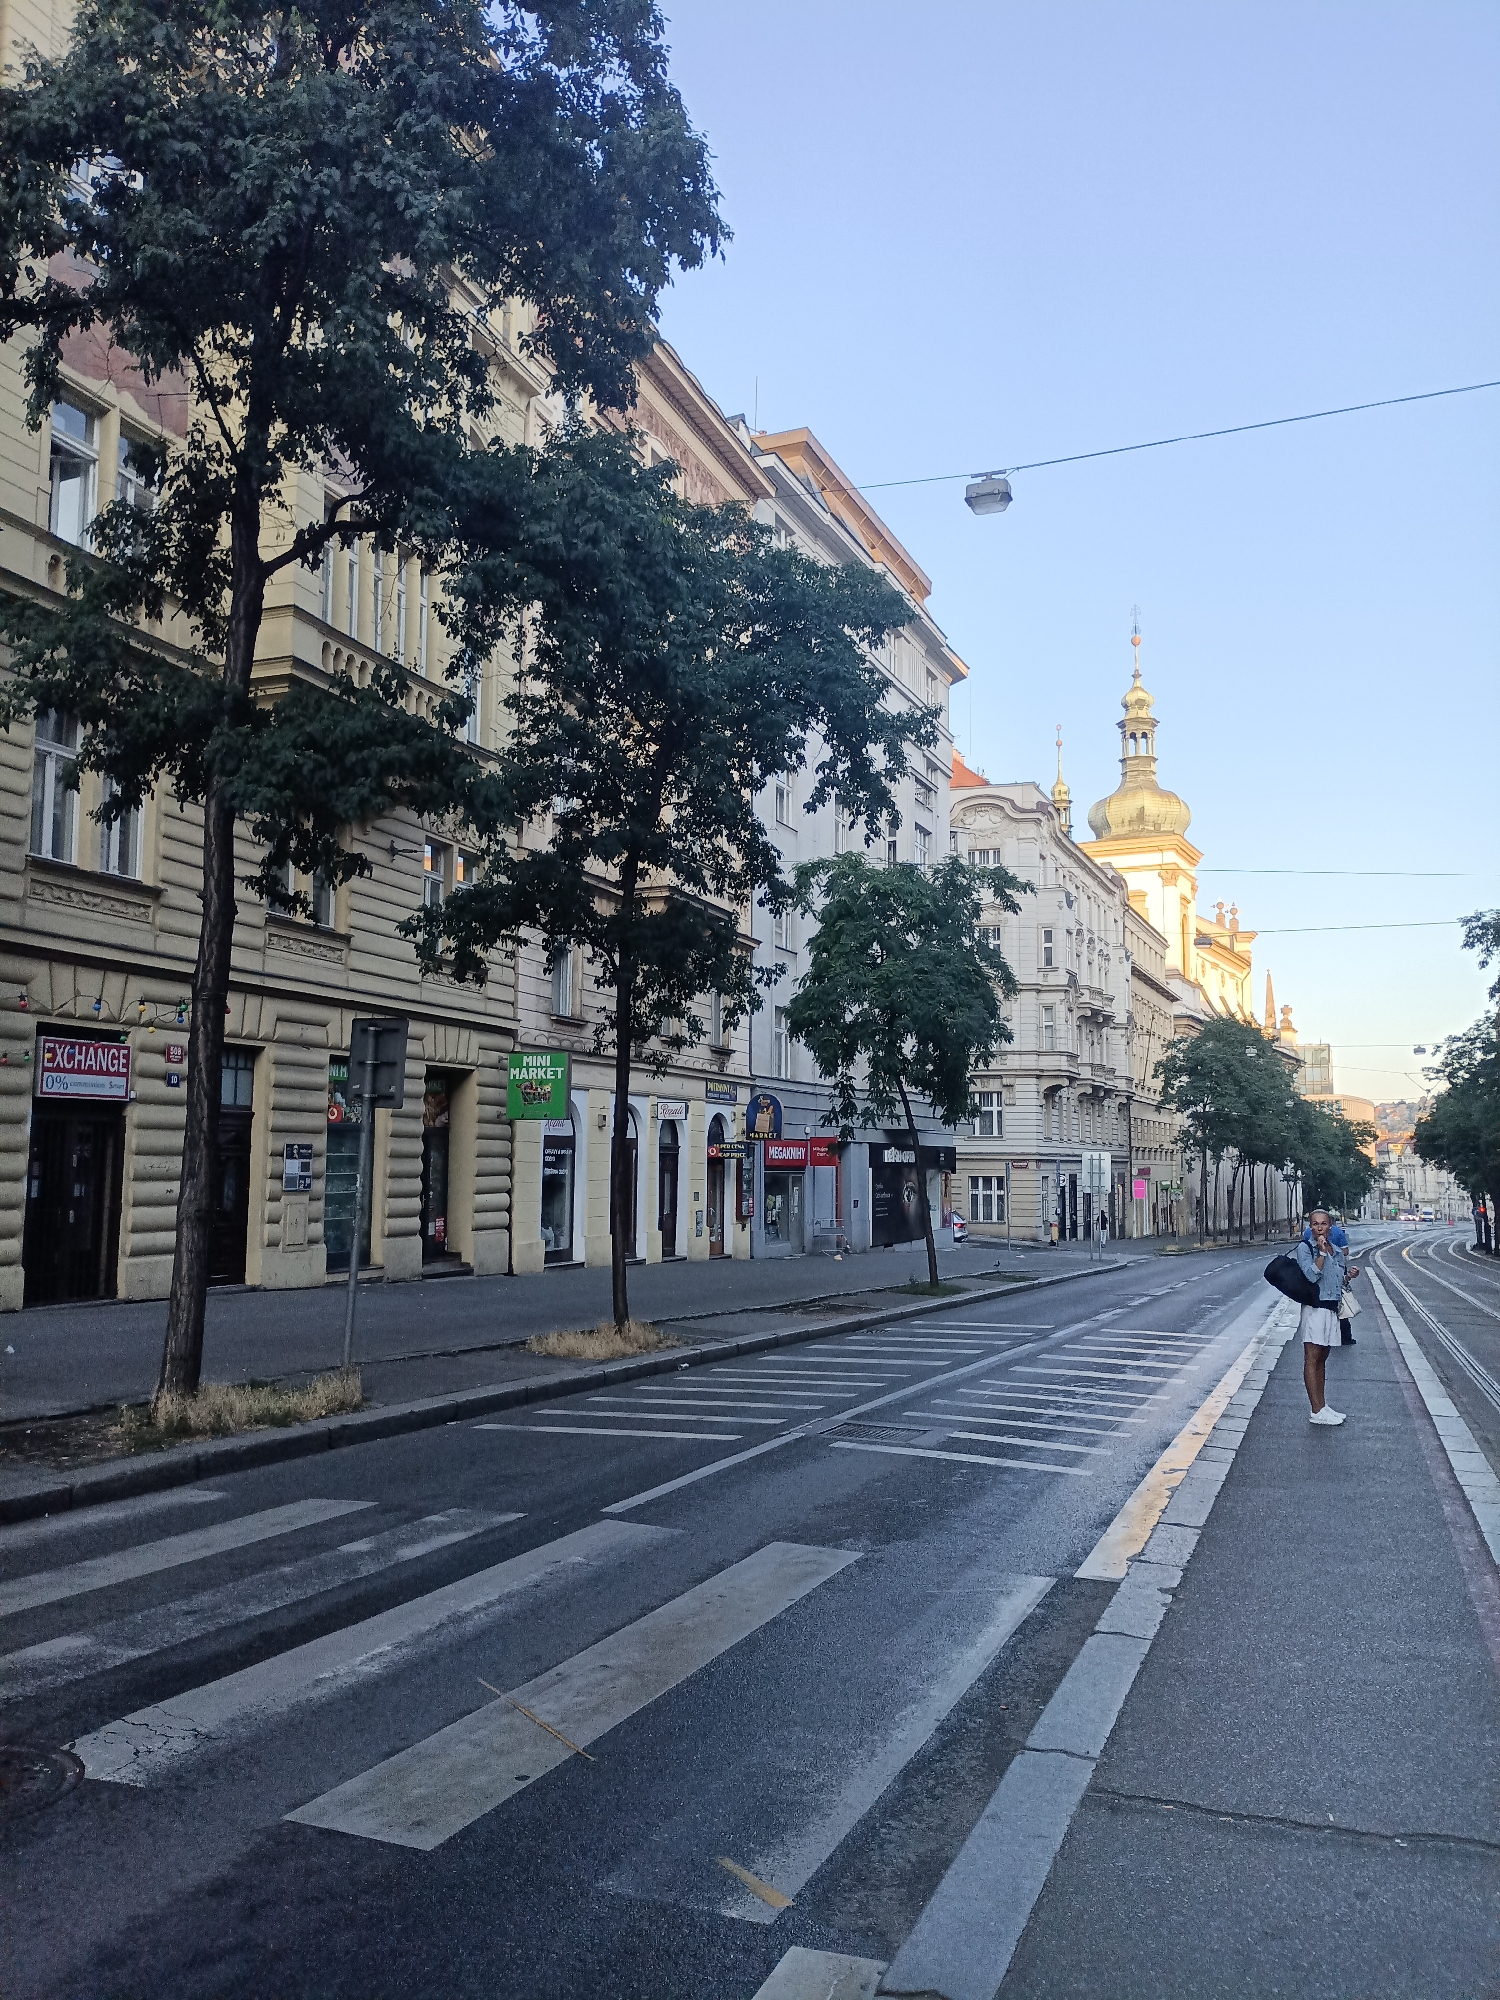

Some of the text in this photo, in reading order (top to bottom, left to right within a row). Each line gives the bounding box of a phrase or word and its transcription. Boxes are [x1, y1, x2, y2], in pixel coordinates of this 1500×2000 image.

[44, 1043, 128, 1073] EXCHANGE
[522, 1055, 551, 1067] MINI
[171, 1075, 178, 1084] 10
[510, 1067, 564, 1080] MARKET
[45, 1075, 69, 1091] 0%
[768, 1146, 806, 1160] MEGAKNIHY
